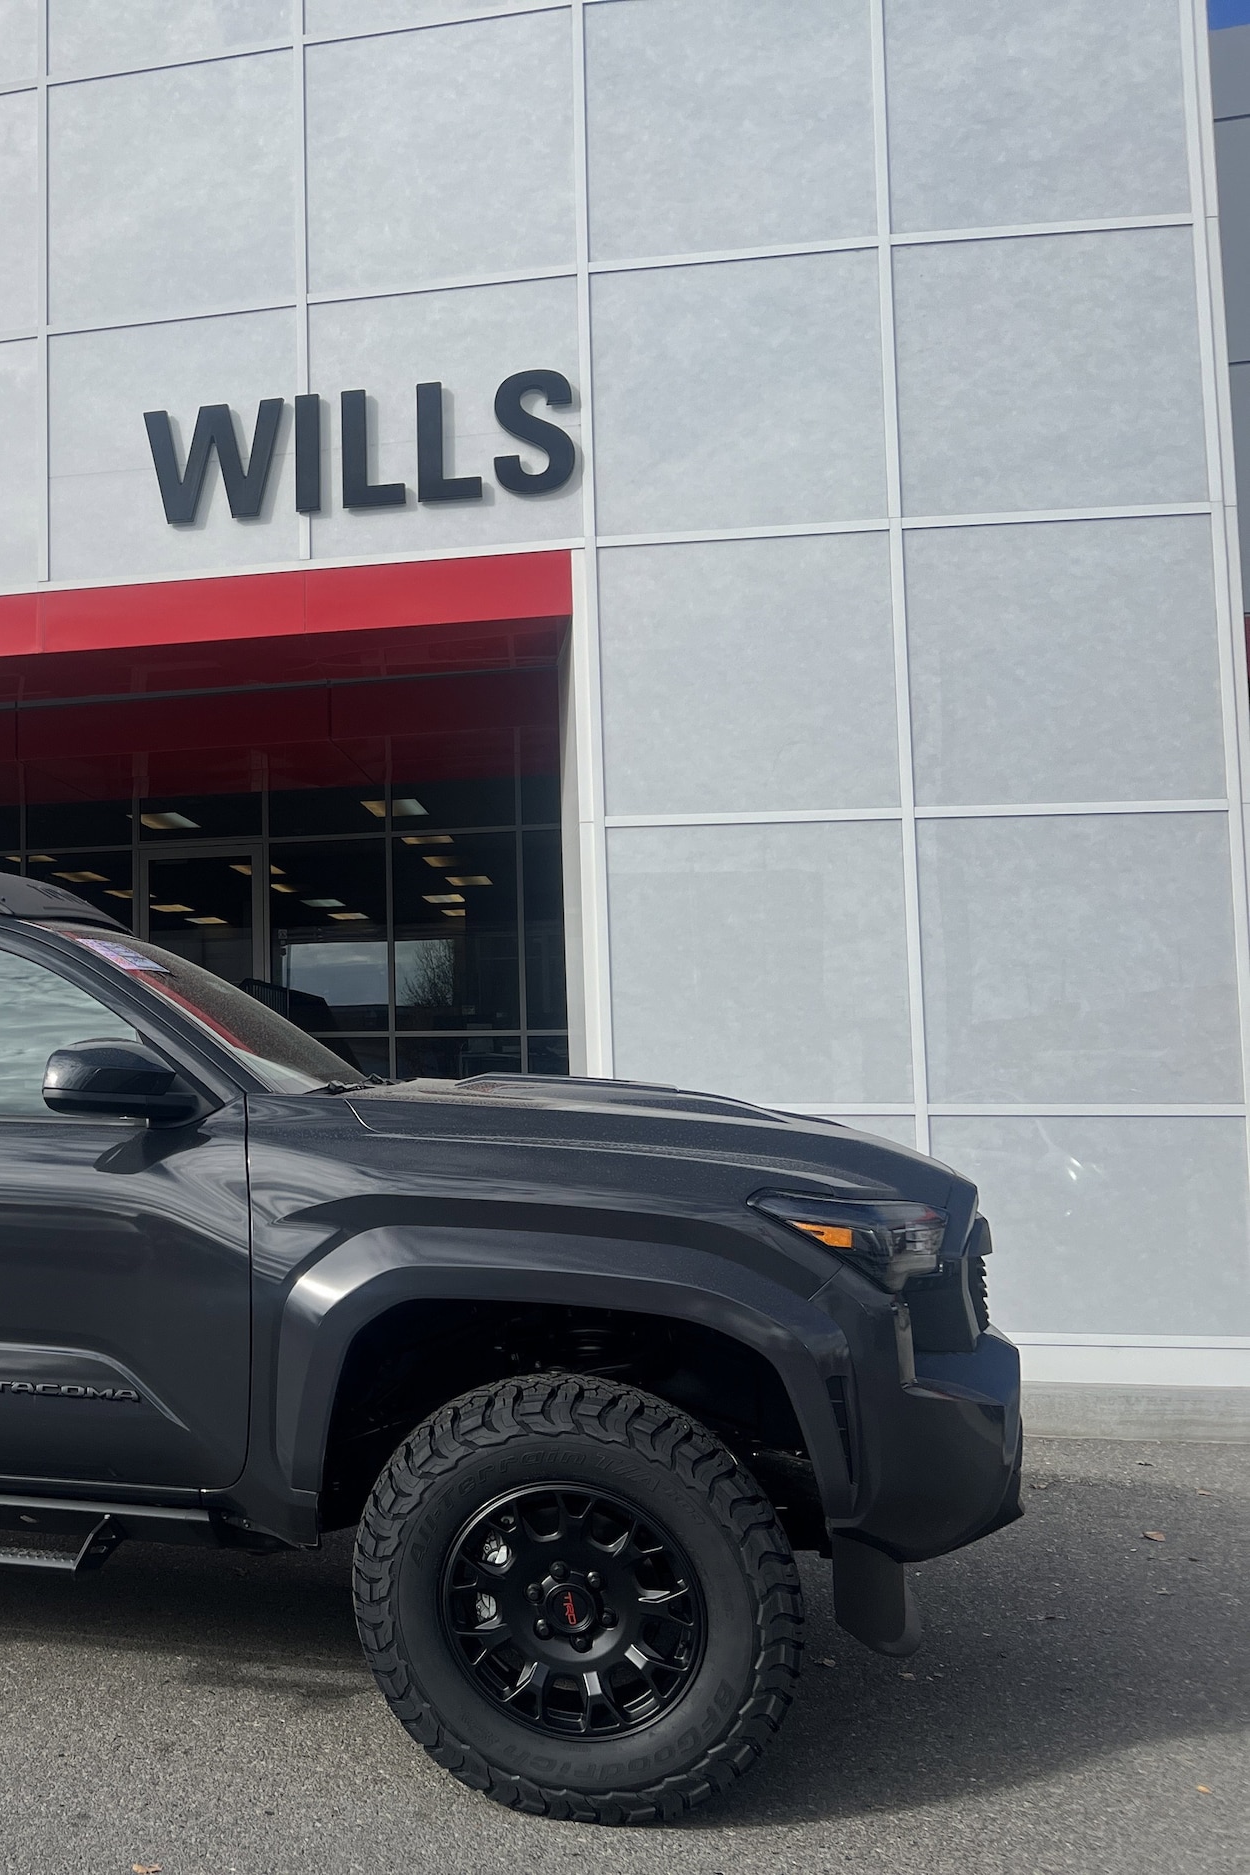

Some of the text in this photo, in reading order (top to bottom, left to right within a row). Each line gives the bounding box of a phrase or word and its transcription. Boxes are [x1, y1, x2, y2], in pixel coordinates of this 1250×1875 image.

[143, 368, 576, 525] WILLS
[409, 1446, 588, 1569] All-Terrain
[563, 1591, 578, 1626] TRD
[501, 1680, 736, 1784] BFGoodrich
